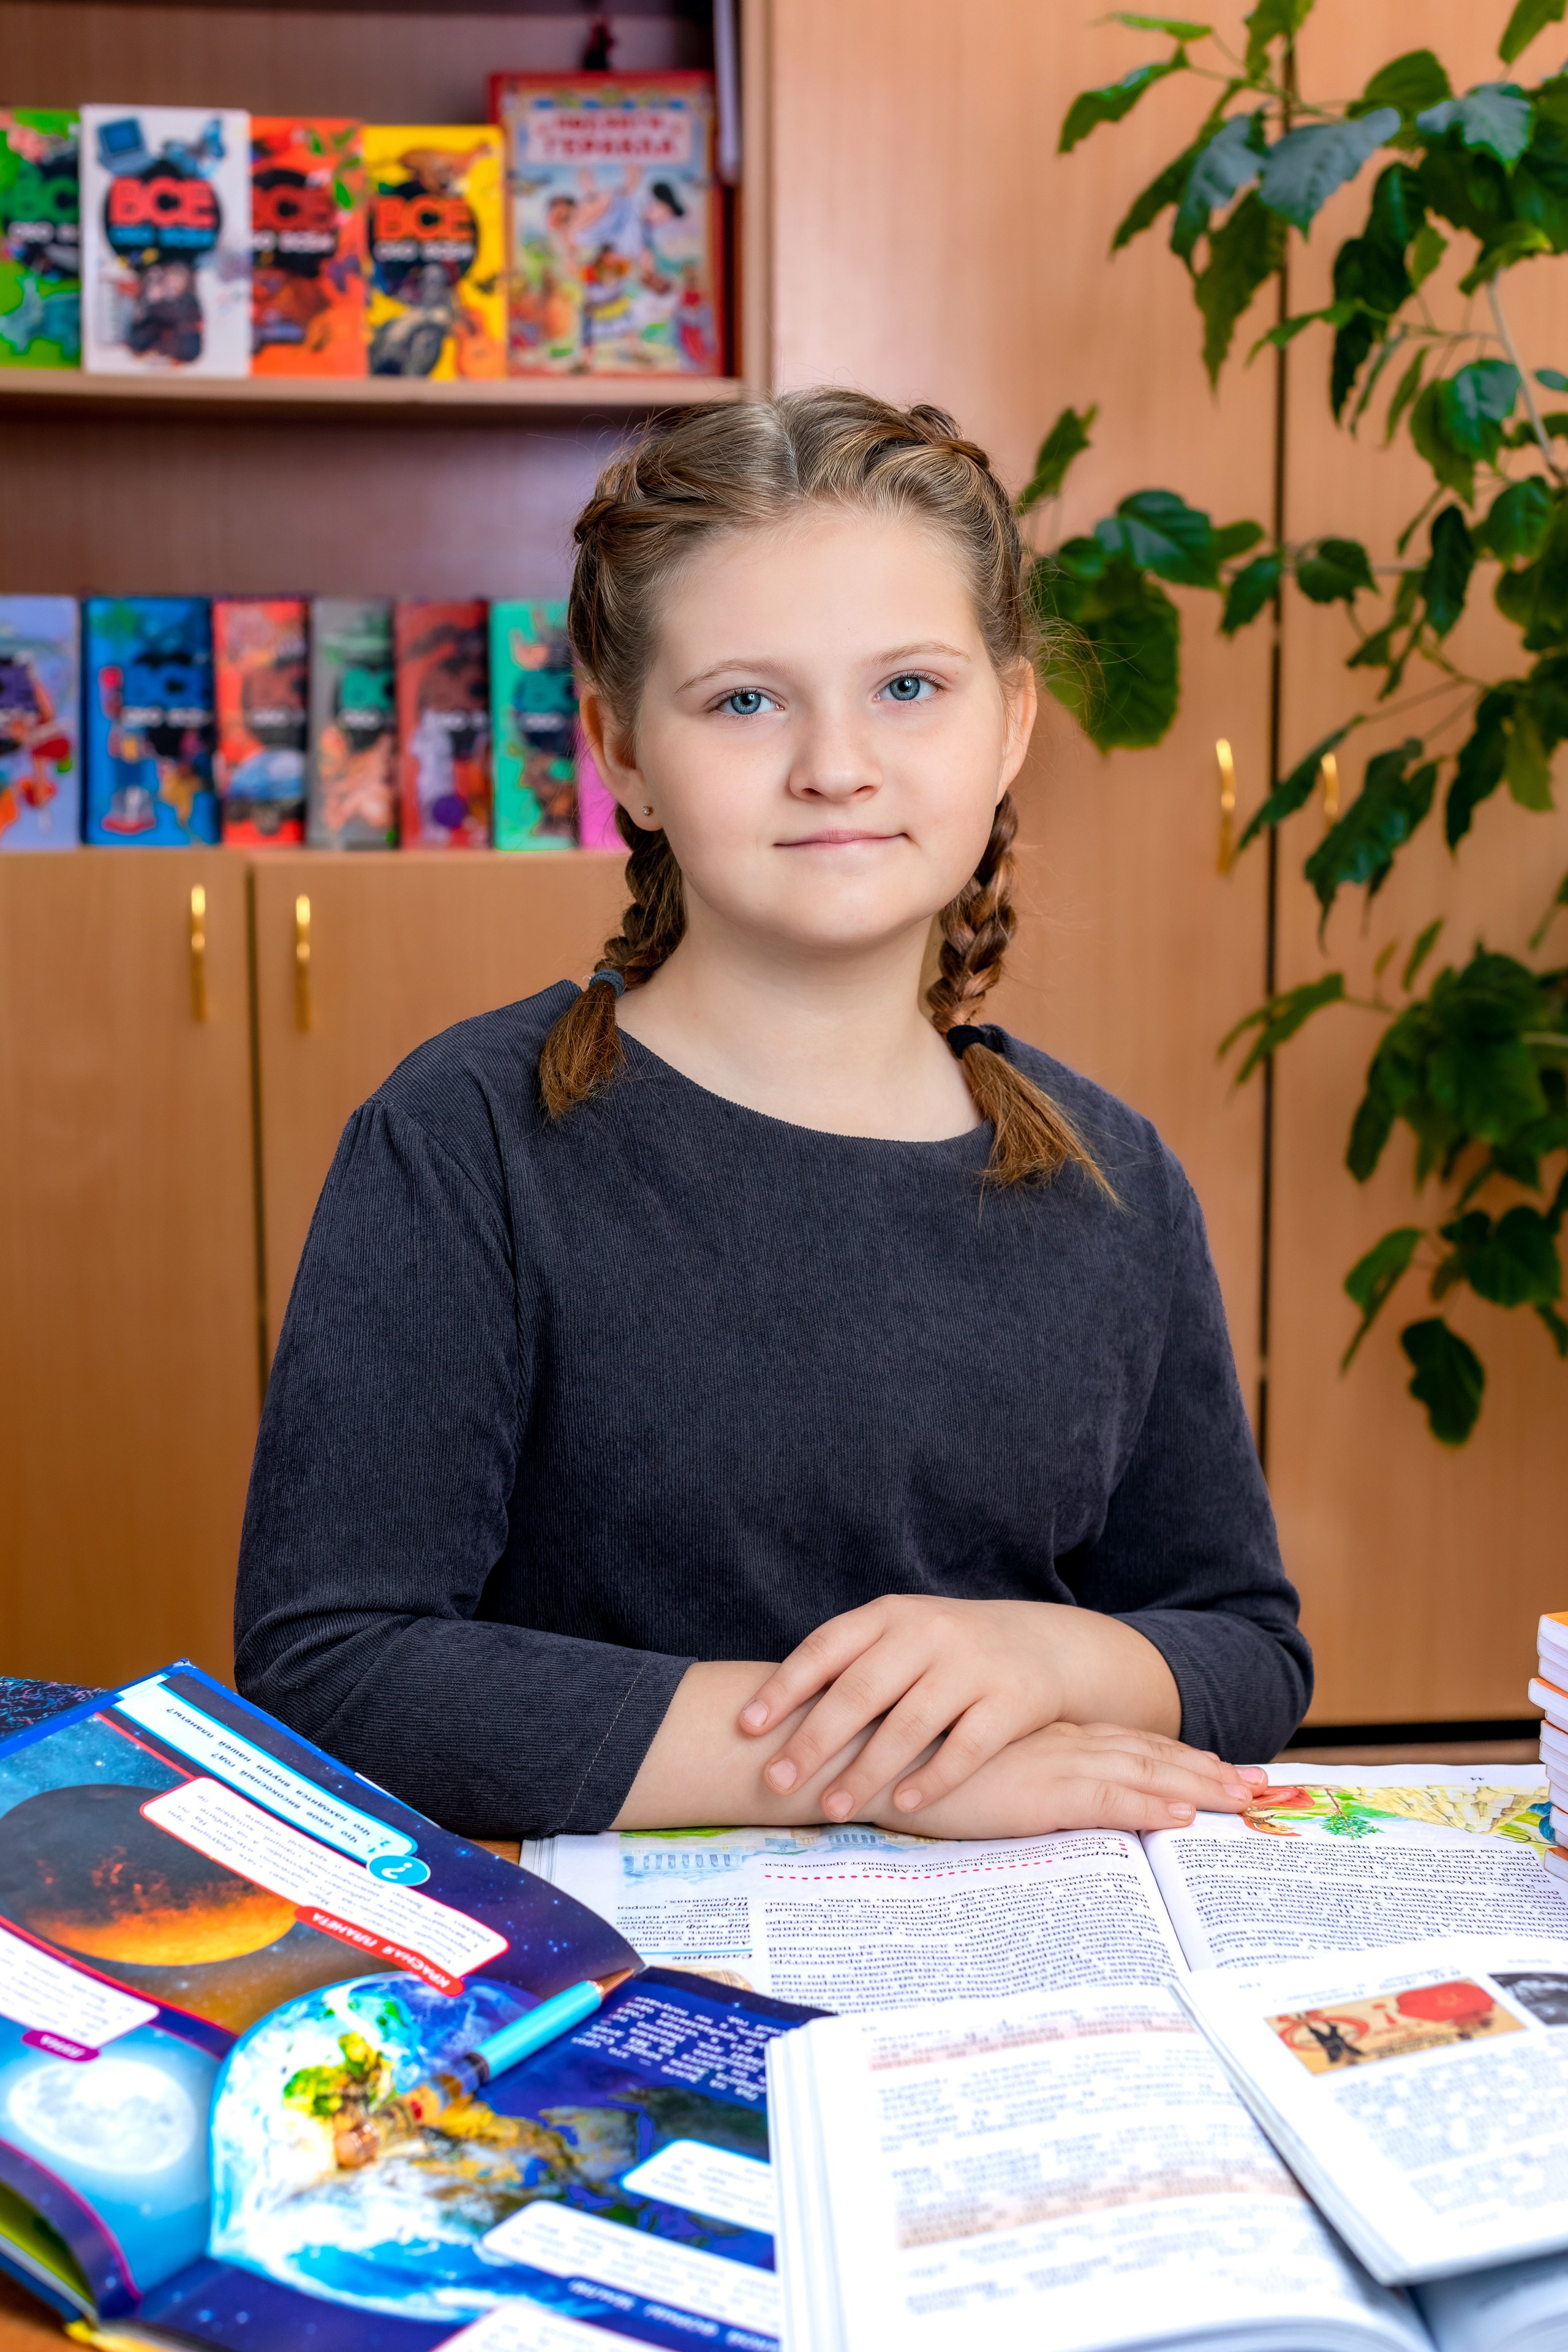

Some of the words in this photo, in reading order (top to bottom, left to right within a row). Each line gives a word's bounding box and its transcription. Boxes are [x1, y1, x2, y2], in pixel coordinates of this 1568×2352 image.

[167, 1709, 214, 1738] планеты?
[218, 1741, 251, 1762] нашей
[211, 1754, 235, 1767] год?
[257, 1765, 290, 1787] внутри
[240, 1771, 300, 1808] високосный
[296, 1790, 347, 1821] находится
[307, 1812, 333, 1828] такое
[341, 1831, 357, 1843] Что
[354, 1824, 370, 1836] Что
[1058, 1837, 1124, 1845] тектурные
[981, 1844, 1054, 1857] памятники?
[1019, 1850, 1069, 1861] спорили
[1063, 1852, 1128, 1860] Вопросы
[926, 1863, 982, 1872] Посейдон
[312, 1912, 378, 1947] ПЛАНЕТА
[382, 1945, 450, 1988] КРАСНАЯ
